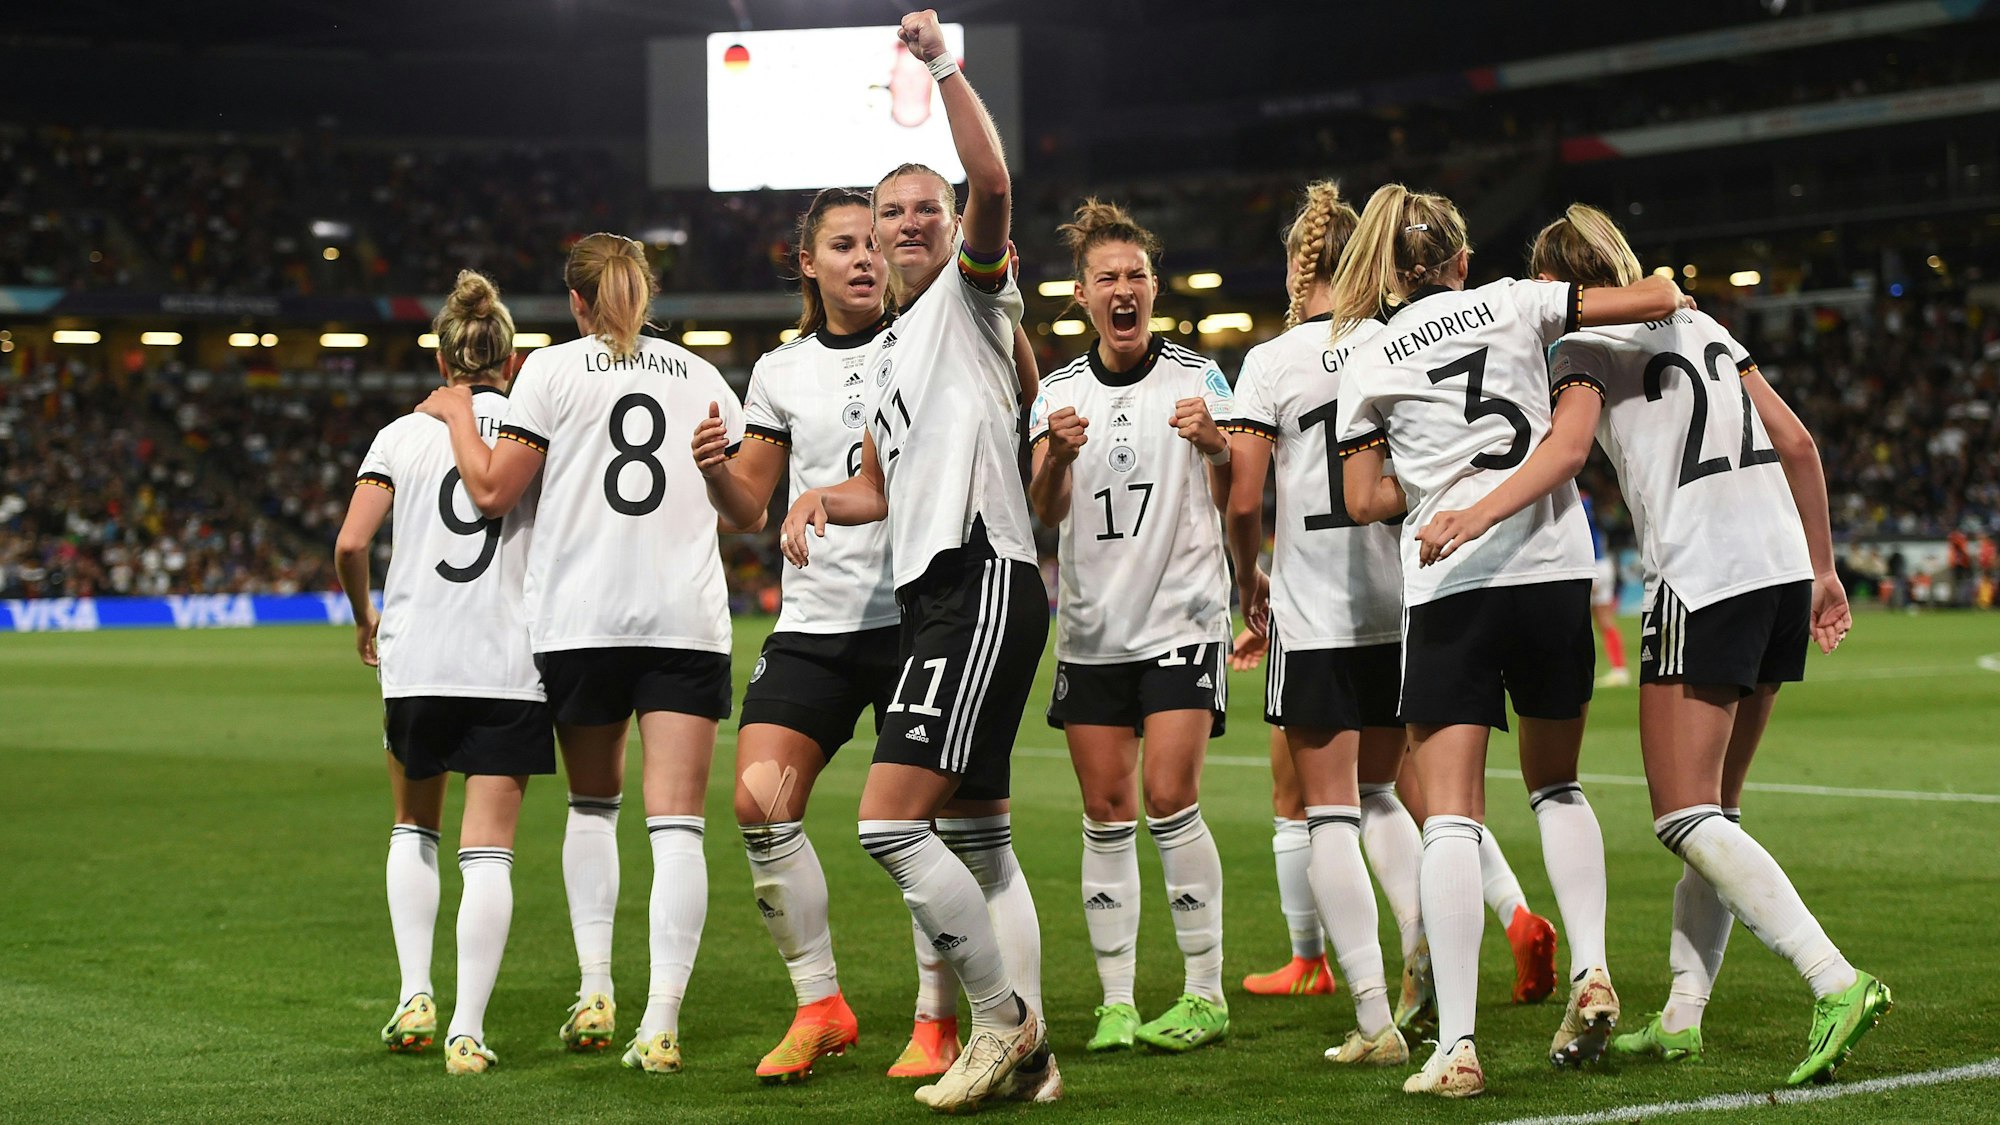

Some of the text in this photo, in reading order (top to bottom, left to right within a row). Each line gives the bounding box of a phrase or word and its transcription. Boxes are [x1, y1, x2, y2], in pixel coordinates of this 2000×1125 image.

[1383, 302, 1495, 365] HENDRICH
[586, 352, 688, 379] LOHMANN
[478, 416, 503, 437] TH
[1426, 345, 1532, 470] 3
[1643, 342, 1781, 488] 22
[604, 393, 666, 516] 8
[435, 465, 503, 583] 9
[1094, 483, 1154, 540] 17
[7, 597, 98, 632] VISA
[166, 594, 255, 629] VISA
[886, 656, 947, 717] 11
[905, 733, 930, 743] adidas
